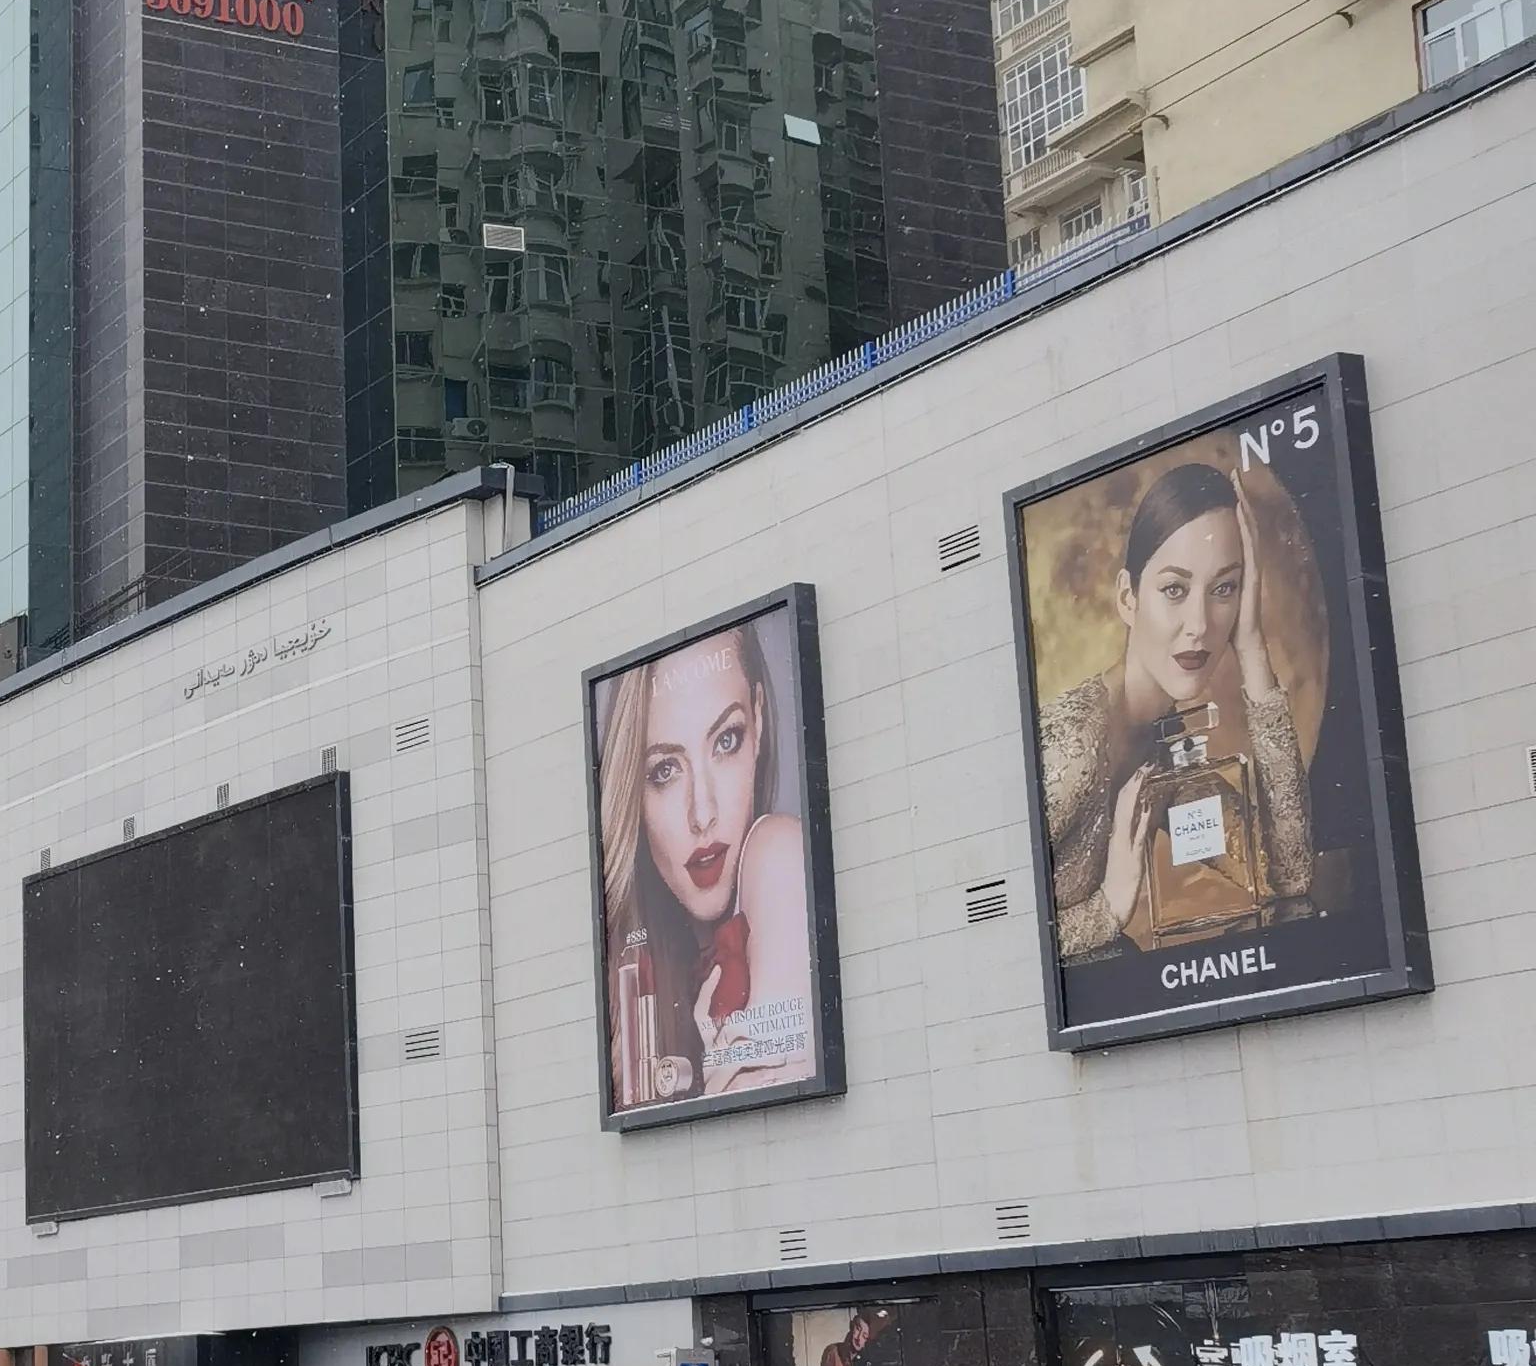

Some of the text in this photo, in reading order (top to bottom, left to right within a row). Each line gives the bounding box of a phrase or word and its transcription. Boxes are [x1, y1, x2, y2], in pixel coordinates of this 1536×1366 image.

[1174, 818, 1220, 837] CHANEL
[1161, 945, 1277, 989] CHANEL
[767, 996, 804, 1019] ROUGE
